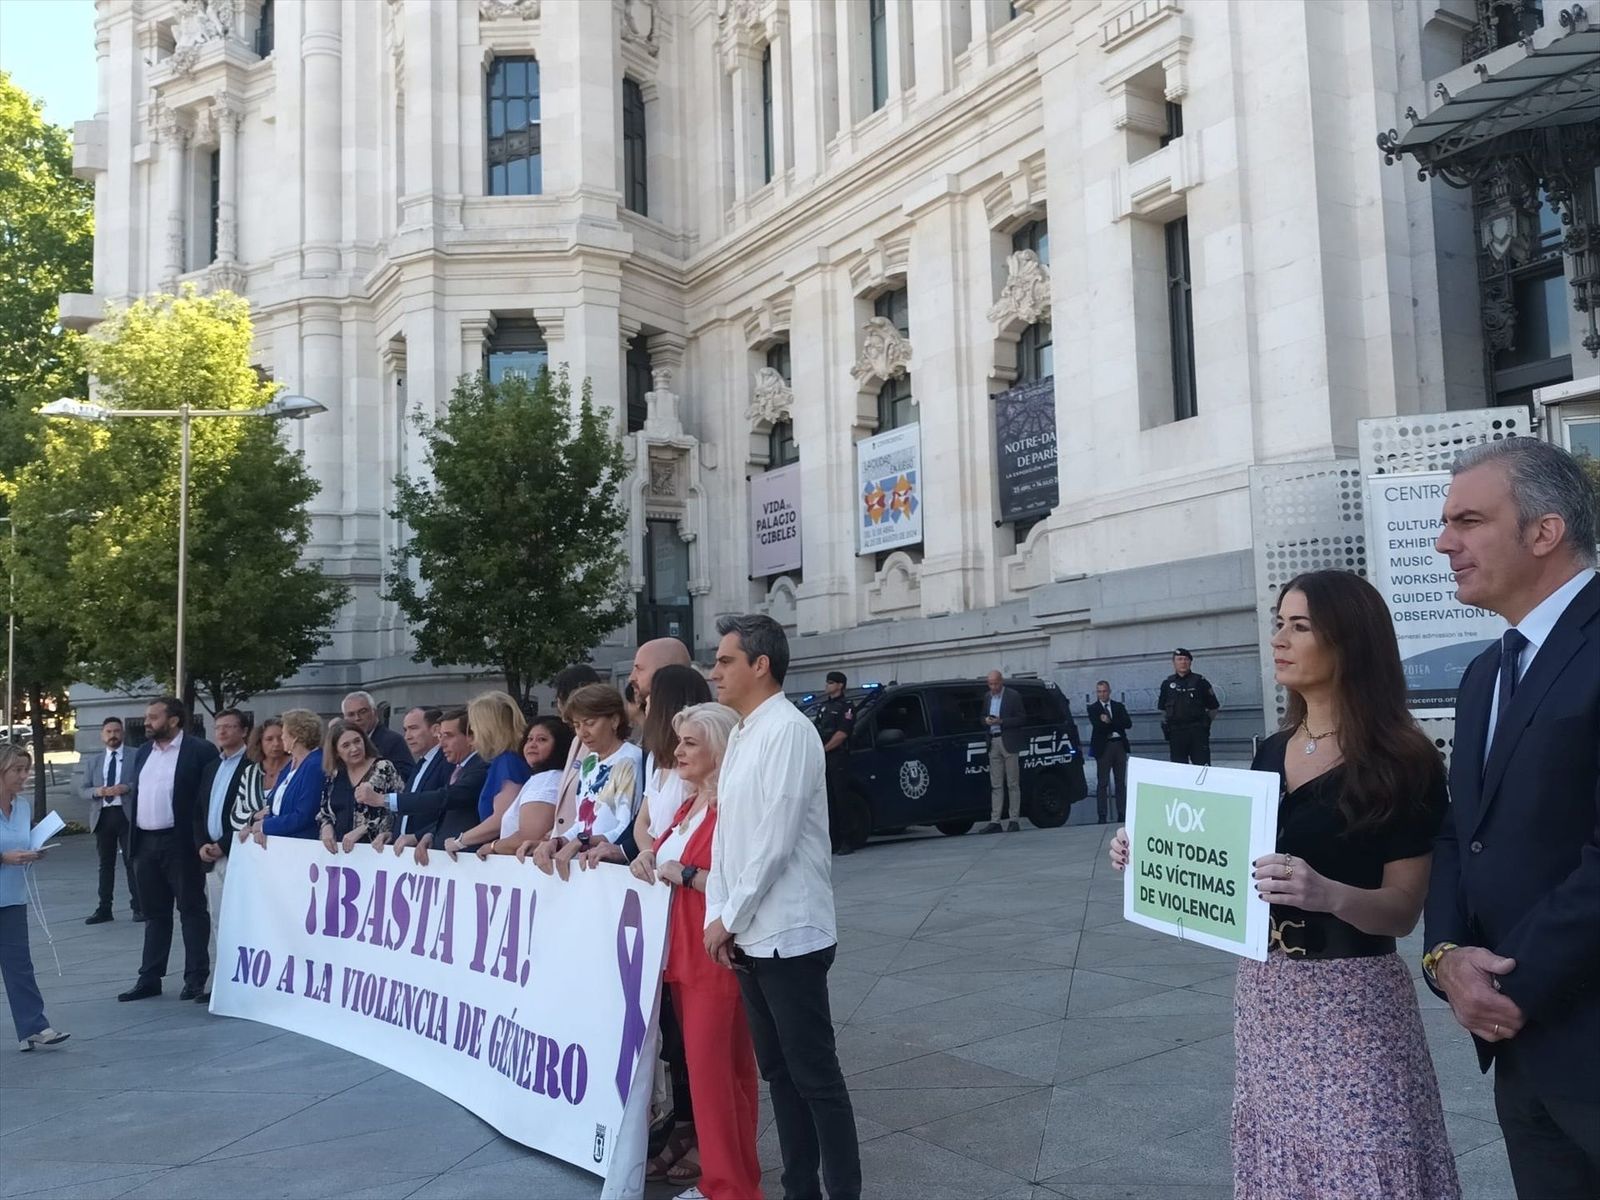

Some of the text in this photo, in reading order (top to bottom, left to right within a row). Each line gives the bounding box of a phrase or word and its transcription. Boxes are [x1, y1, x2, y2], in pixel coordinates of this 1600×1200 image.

[1017, 445, 1059, 467] DE PARÍS
[762, 498, 786, 515] VIDA
[1390, 555, 1433, 567] MUSIC
[1392, 591, 1443, 603] GUIDED
[1394, 608, 1485, 622] OBSERVATION
[1024, 753, 1073, 769] MADRID
[1165, 798, 1205, 833] VOX
[1147, 836, 1228, 868] CON TODAS
[1141, 860, 1236, 897] LAS VÍCTIMAS
[1140, 885, 1236, 926] DE VIOLENCIA
[305, 862, 538, 988] ¡BASTA YA!
[231, 945, 588, 1106] NO A LA VIOLENCIA DE GÉNERO
